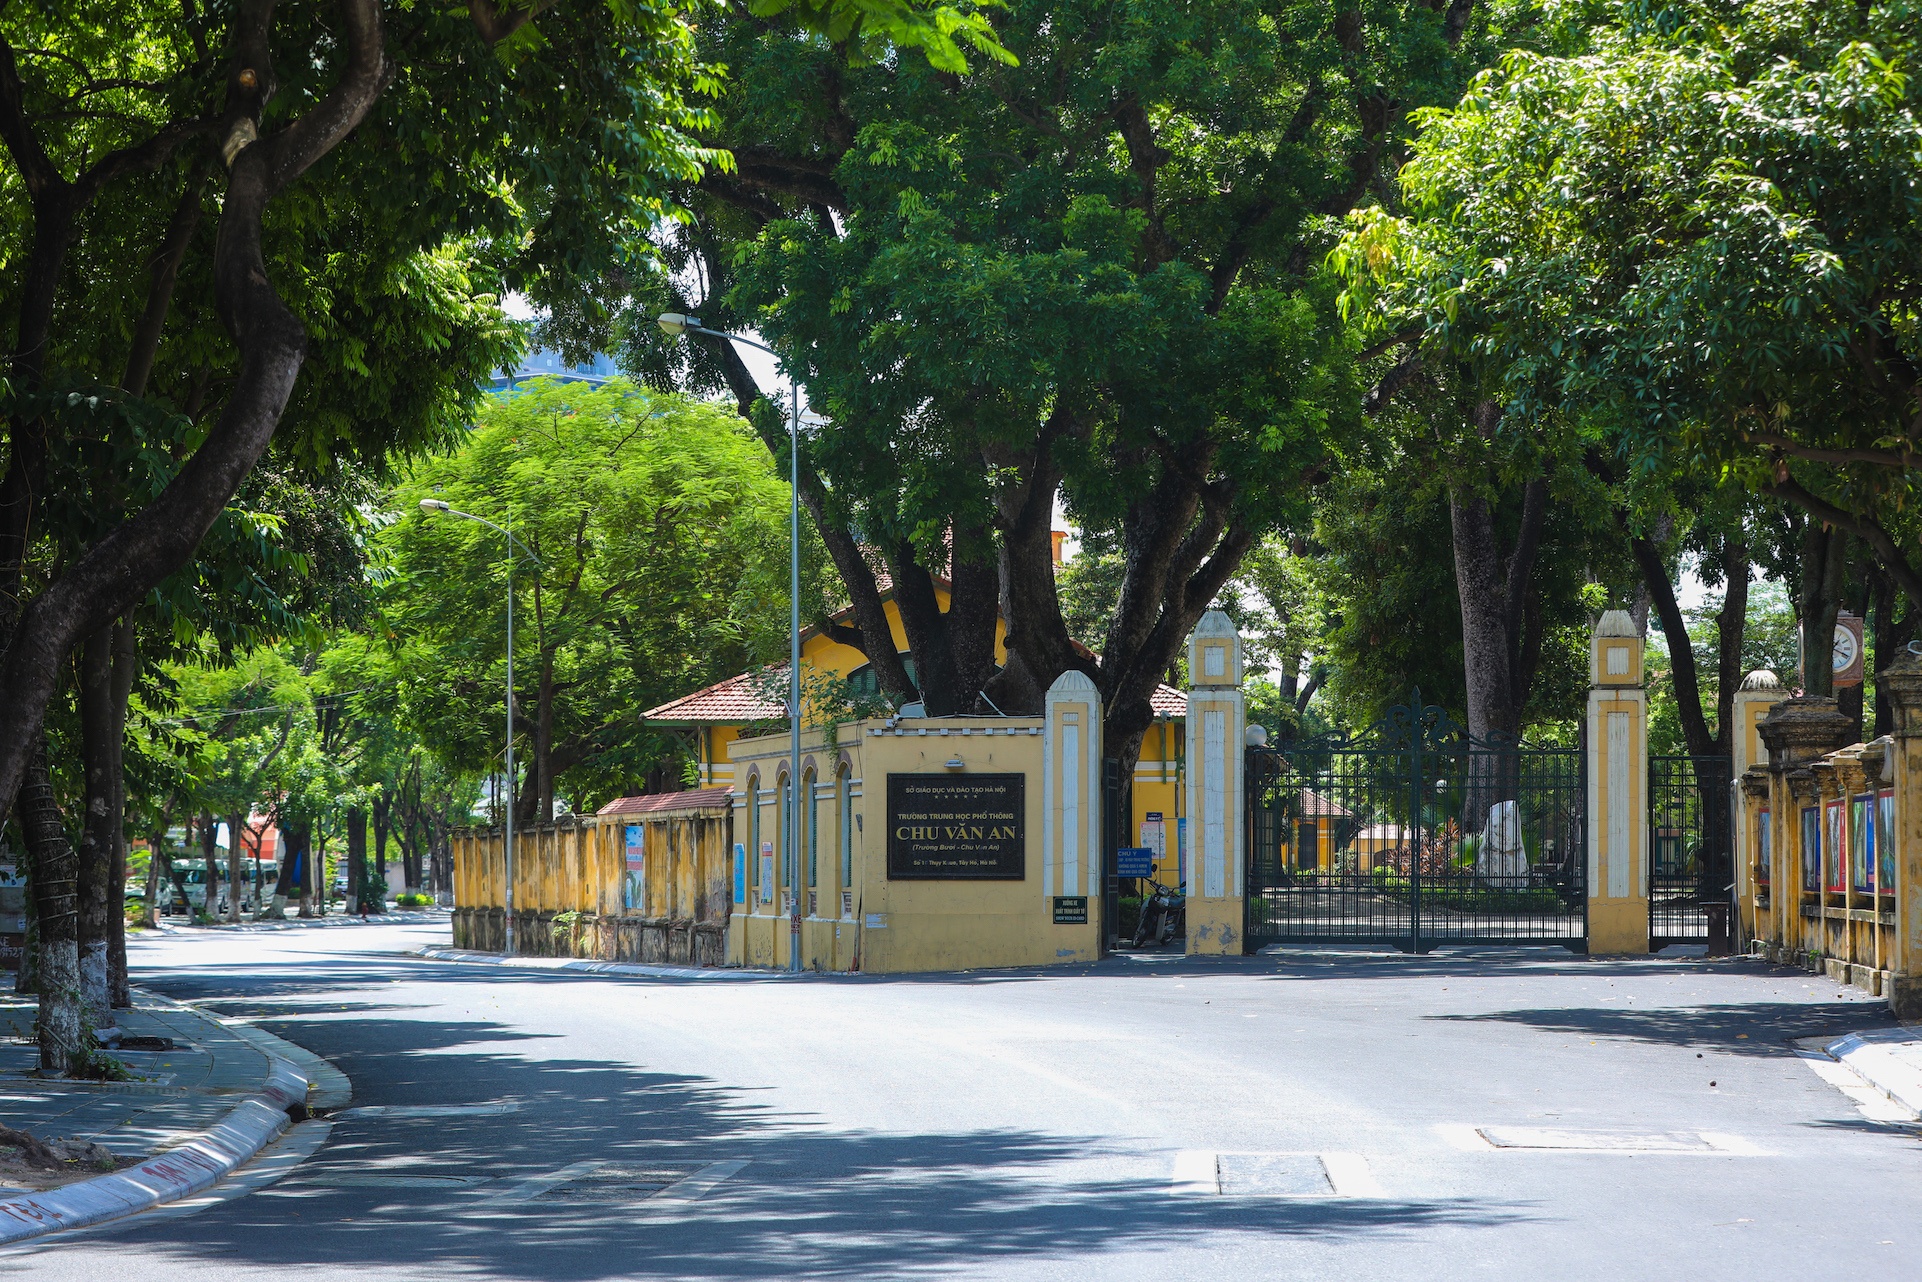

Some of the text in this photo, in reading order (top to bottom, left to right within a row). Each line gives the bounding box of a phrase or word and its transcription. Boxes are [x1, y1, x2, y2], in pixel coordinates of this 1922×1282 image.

[905, 785, 914, 793] SỞ
[995, 786, 1006, 794] NỘI
[972, 810, 988, 819] PHỔ
[896, 822, 1016, 840] CHU VĂN AN
